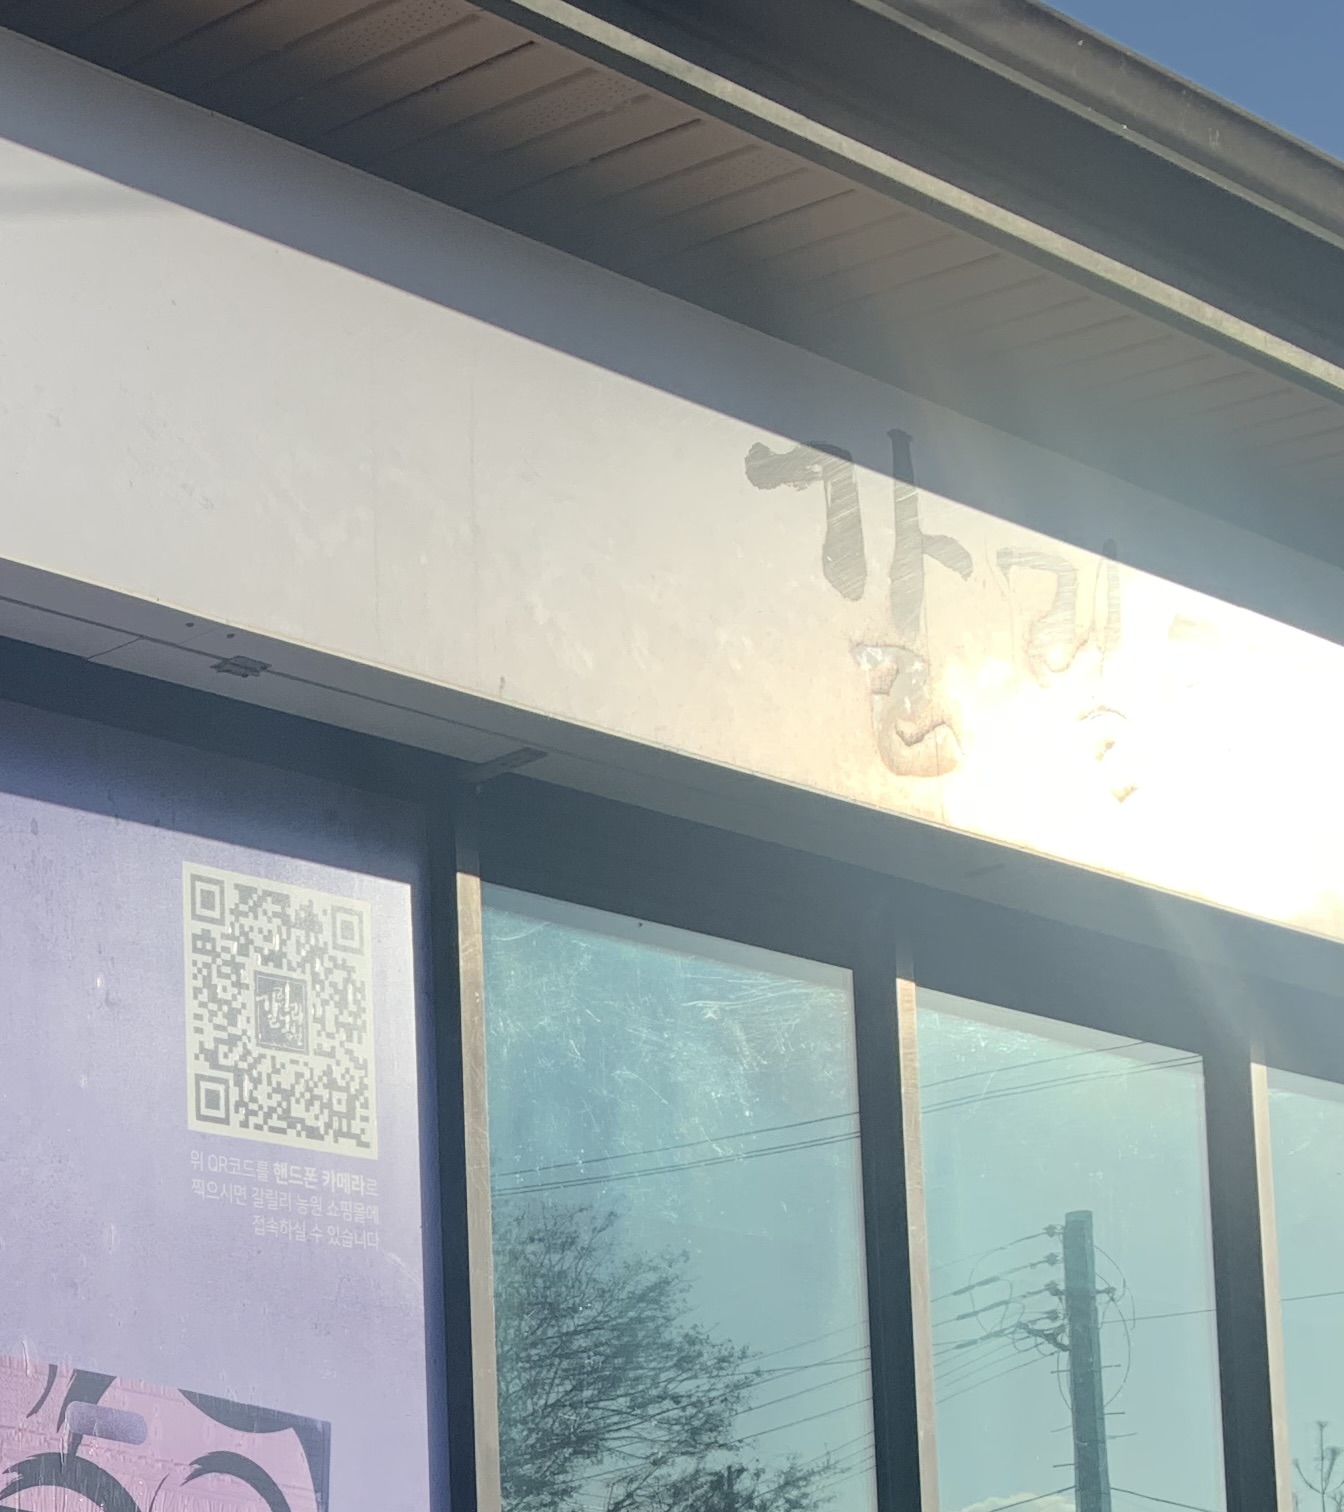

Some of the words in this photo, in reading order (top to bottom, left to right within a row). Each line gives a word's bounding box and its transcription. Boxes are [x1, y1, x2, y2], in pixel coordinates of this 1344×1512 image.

[190, 1150, 204, 1172] 위
[207, 1153, 270, 1182] QR코드를
[273, 1161, 319, 1189] 핸드폰
[321, 1168, 379, 1198] 카메라로
[190, 1178, 248, 1206] 찍으시면
[251, 1186, 292, 1212] 갈릴리
[295, 1194, 324, 1217] 농원
[325, 1199, 380, 1225] 쇼핑몰에
[252, 1214, 307, 1242] 접속하실
[310, 1225, 324, 1244] 수
[326, 1224, 381, 1249] 있습니다
